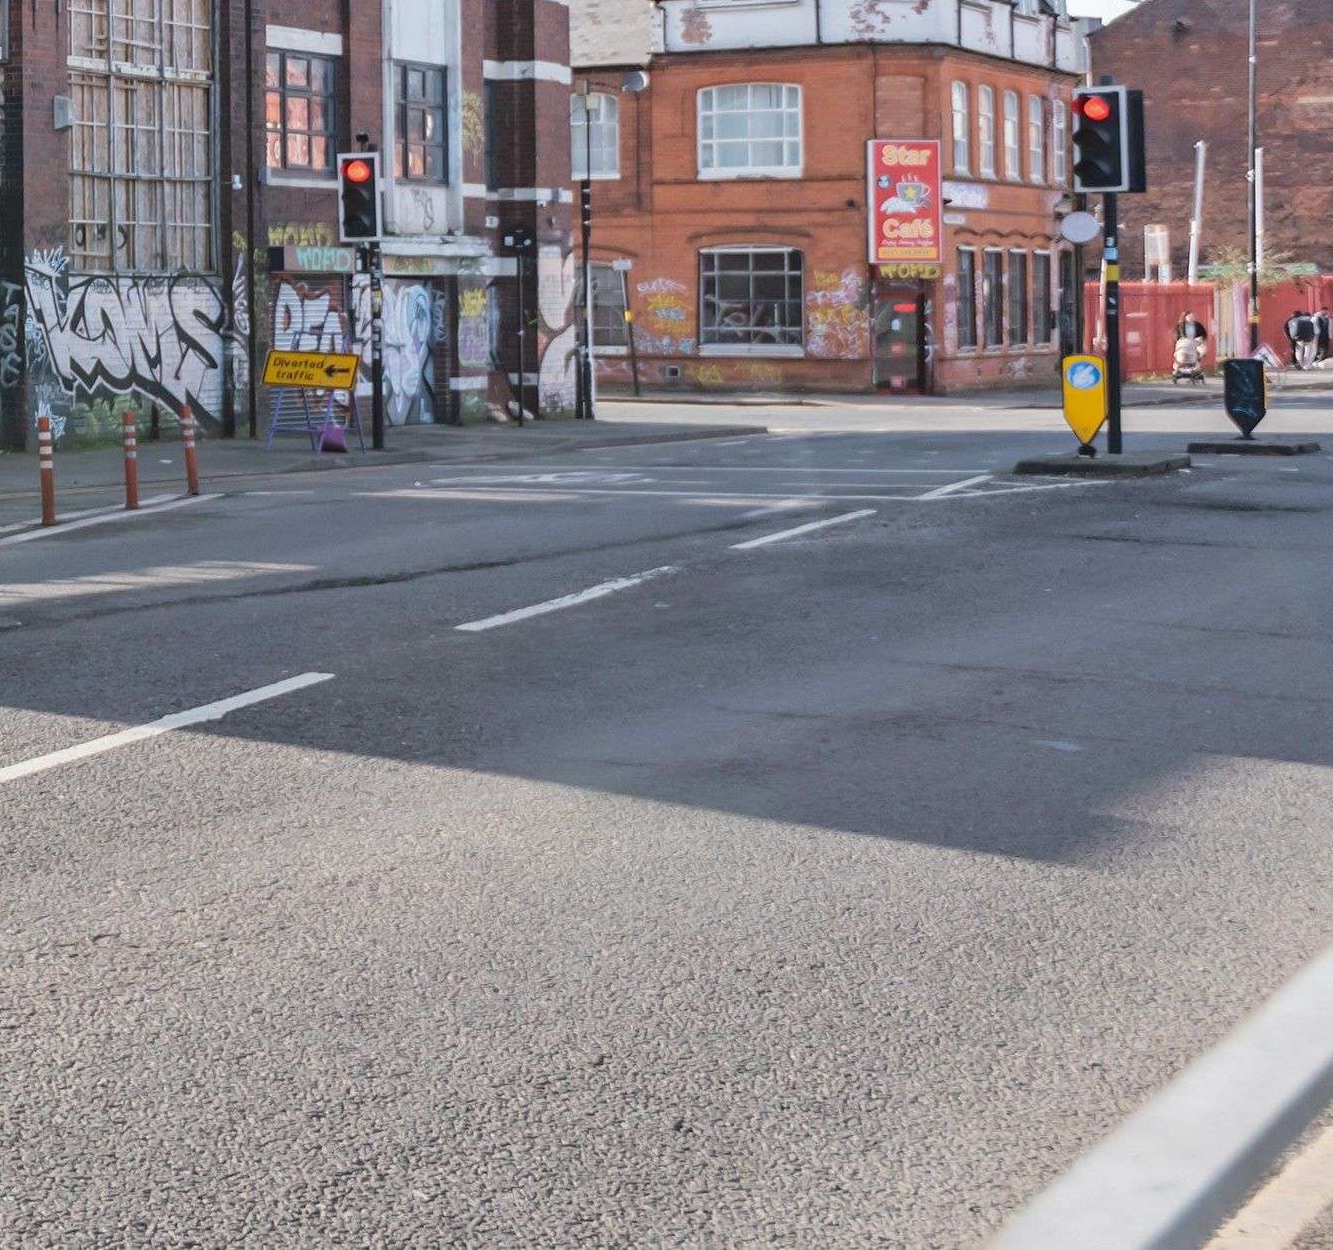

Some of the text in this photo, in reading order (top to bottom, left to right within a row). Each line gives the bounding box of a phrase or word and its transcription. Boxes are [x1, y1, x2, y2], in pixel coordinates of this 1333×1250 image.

[881, 144, 932, 166] Star
[882, 217, 934, 238] Café
[273, 356, 325, 370] Diverted
[276, 368, 315, 381] traffic
